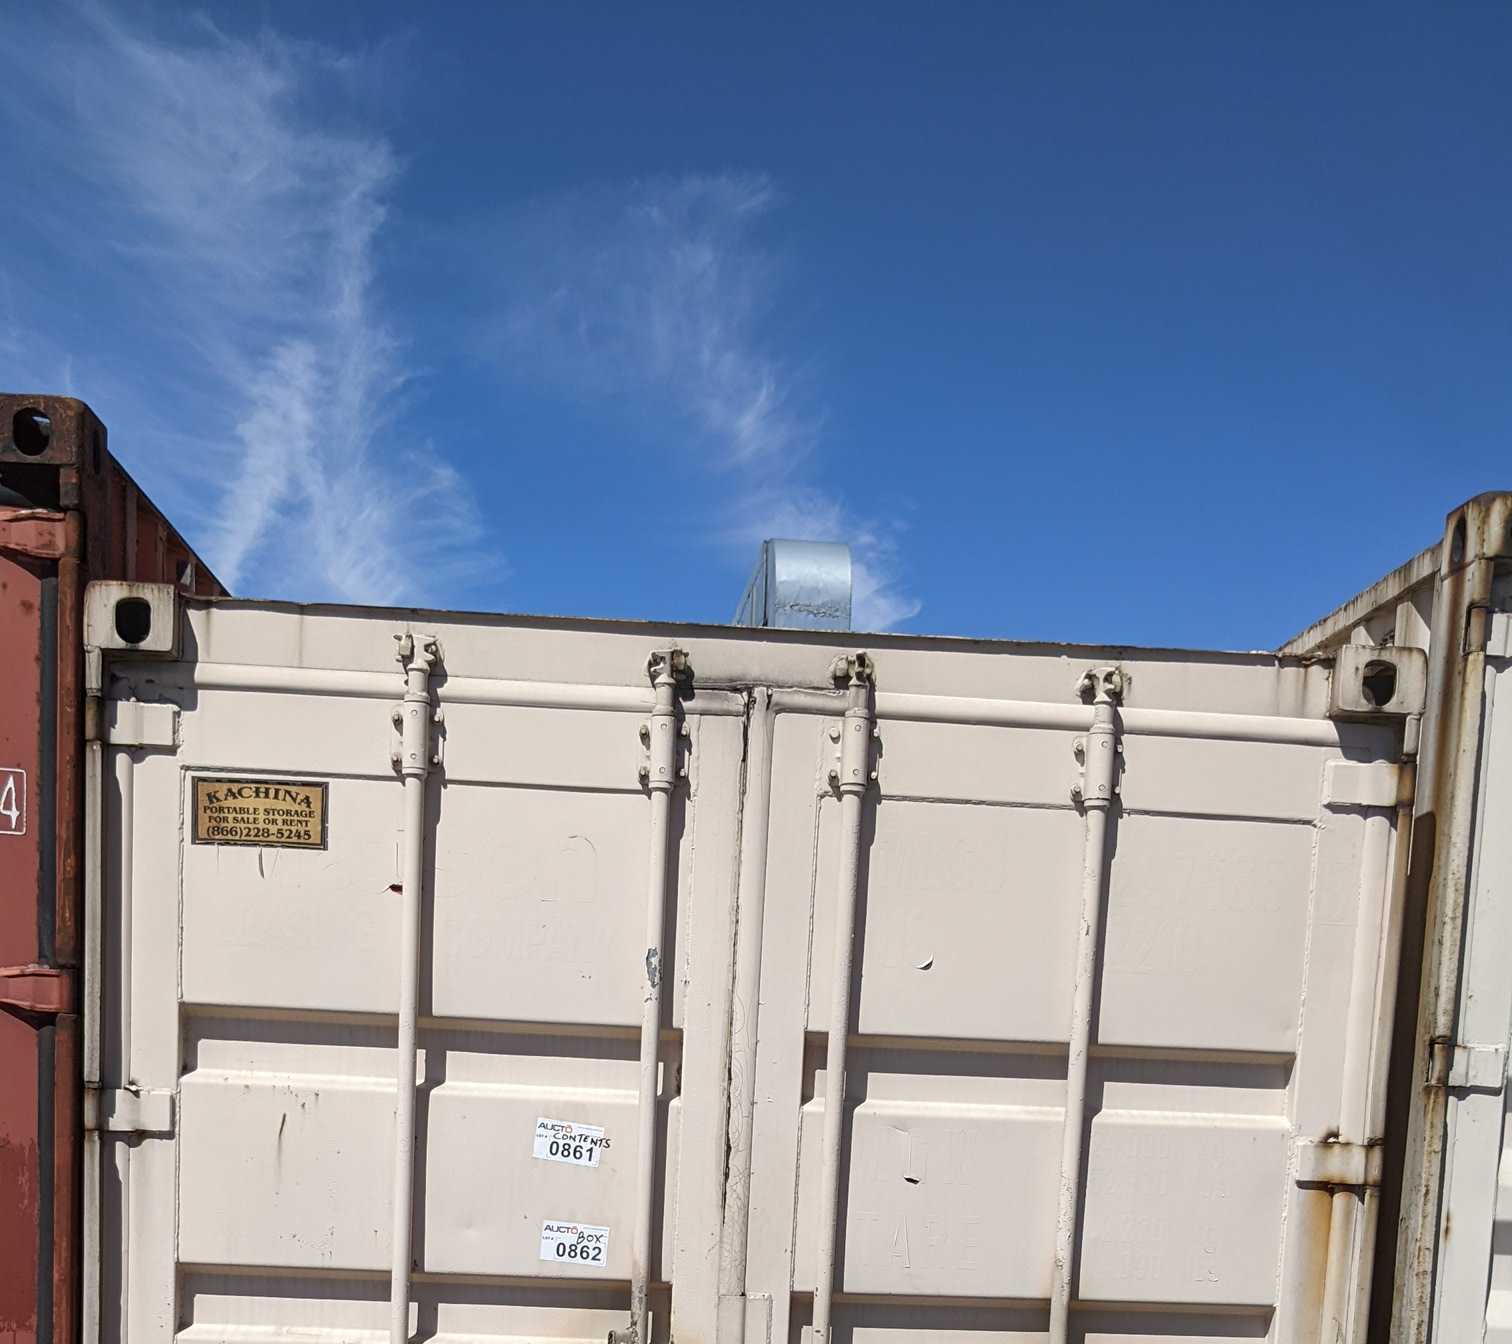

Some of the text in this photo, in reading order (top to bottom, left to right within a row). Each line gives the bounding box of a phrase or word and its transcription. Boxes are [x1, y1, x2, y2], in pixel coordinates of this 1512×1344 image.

[0, 774, 20, 830] 4
[206, 786, 313, 809] KACHINA
[203, 805, 316, 819] PORTABLE STORAGE
[208, 815, 311, 828] FOR SALE OR RENT
[206, 826, 312, 840] (866)228-5245
[553, 1132, 612, 1149] CONTENTS
[549, 1141, 594, 1162] 0861
[556, 1242, 602, 1262] 0862
